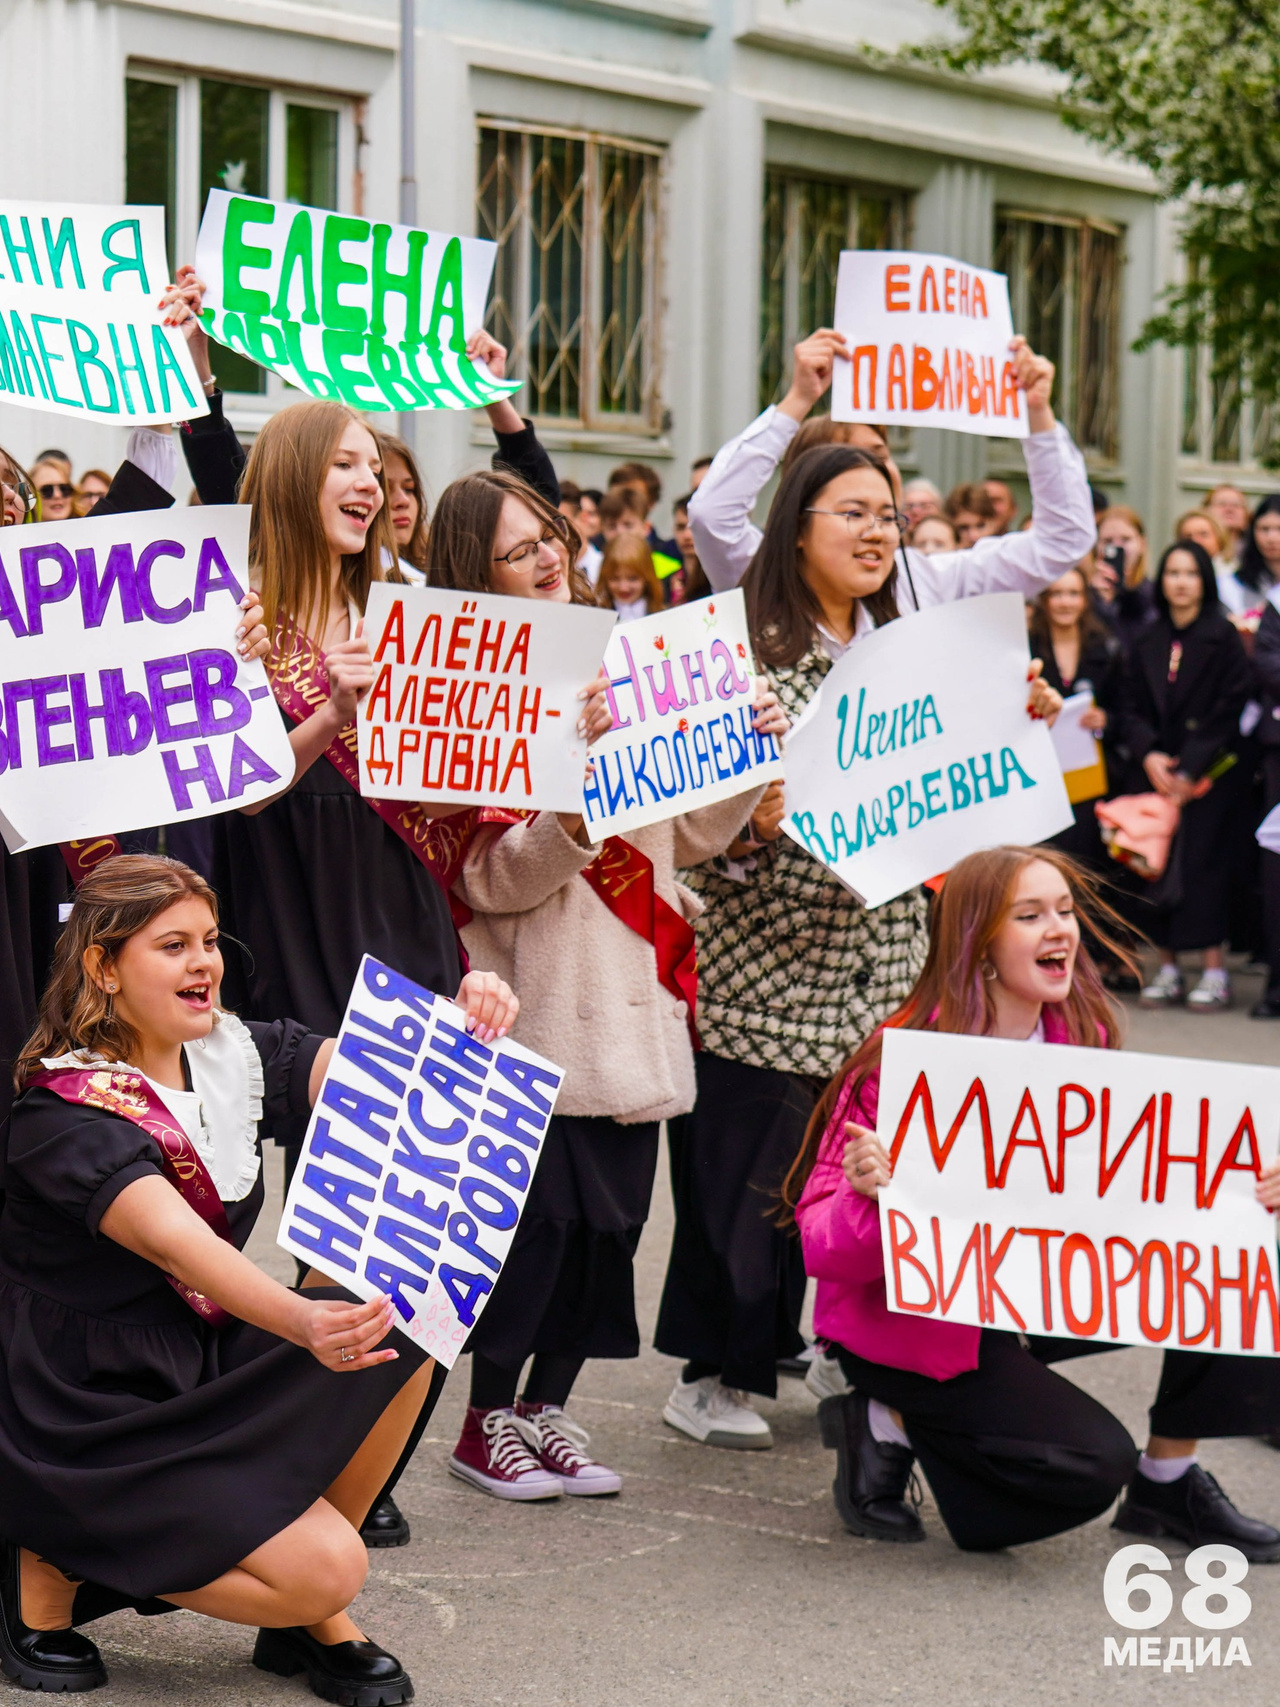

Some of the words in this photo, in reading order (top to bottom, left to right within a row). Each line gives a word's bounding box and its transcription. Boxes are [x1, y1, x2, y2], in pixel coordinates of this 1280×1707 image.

[222, 197, 467, 352] ЕЛЕНА
[885, 264, 989, 319] ЕЛЕНА
[852, 343, 1020, 419] ПАВЛОВНА
[373, 600, 532, 676] АЛЁНА
[366, 663, 561, 735] АЛЕКСАН-
[602, 636, 750, 732] Нина
[161, 733, 281, 812] НА
[365, 726, 532, 796] ДРОВНА
[287, 957, 436, 1274] НАТАЛЬЯ
[888, 1070, 1275, 1213] МАРИНА
[438, 1051, 562, 1328] ДРОВНА
[887, 1208, 1280, 1353] ВИКТОРОВНА
